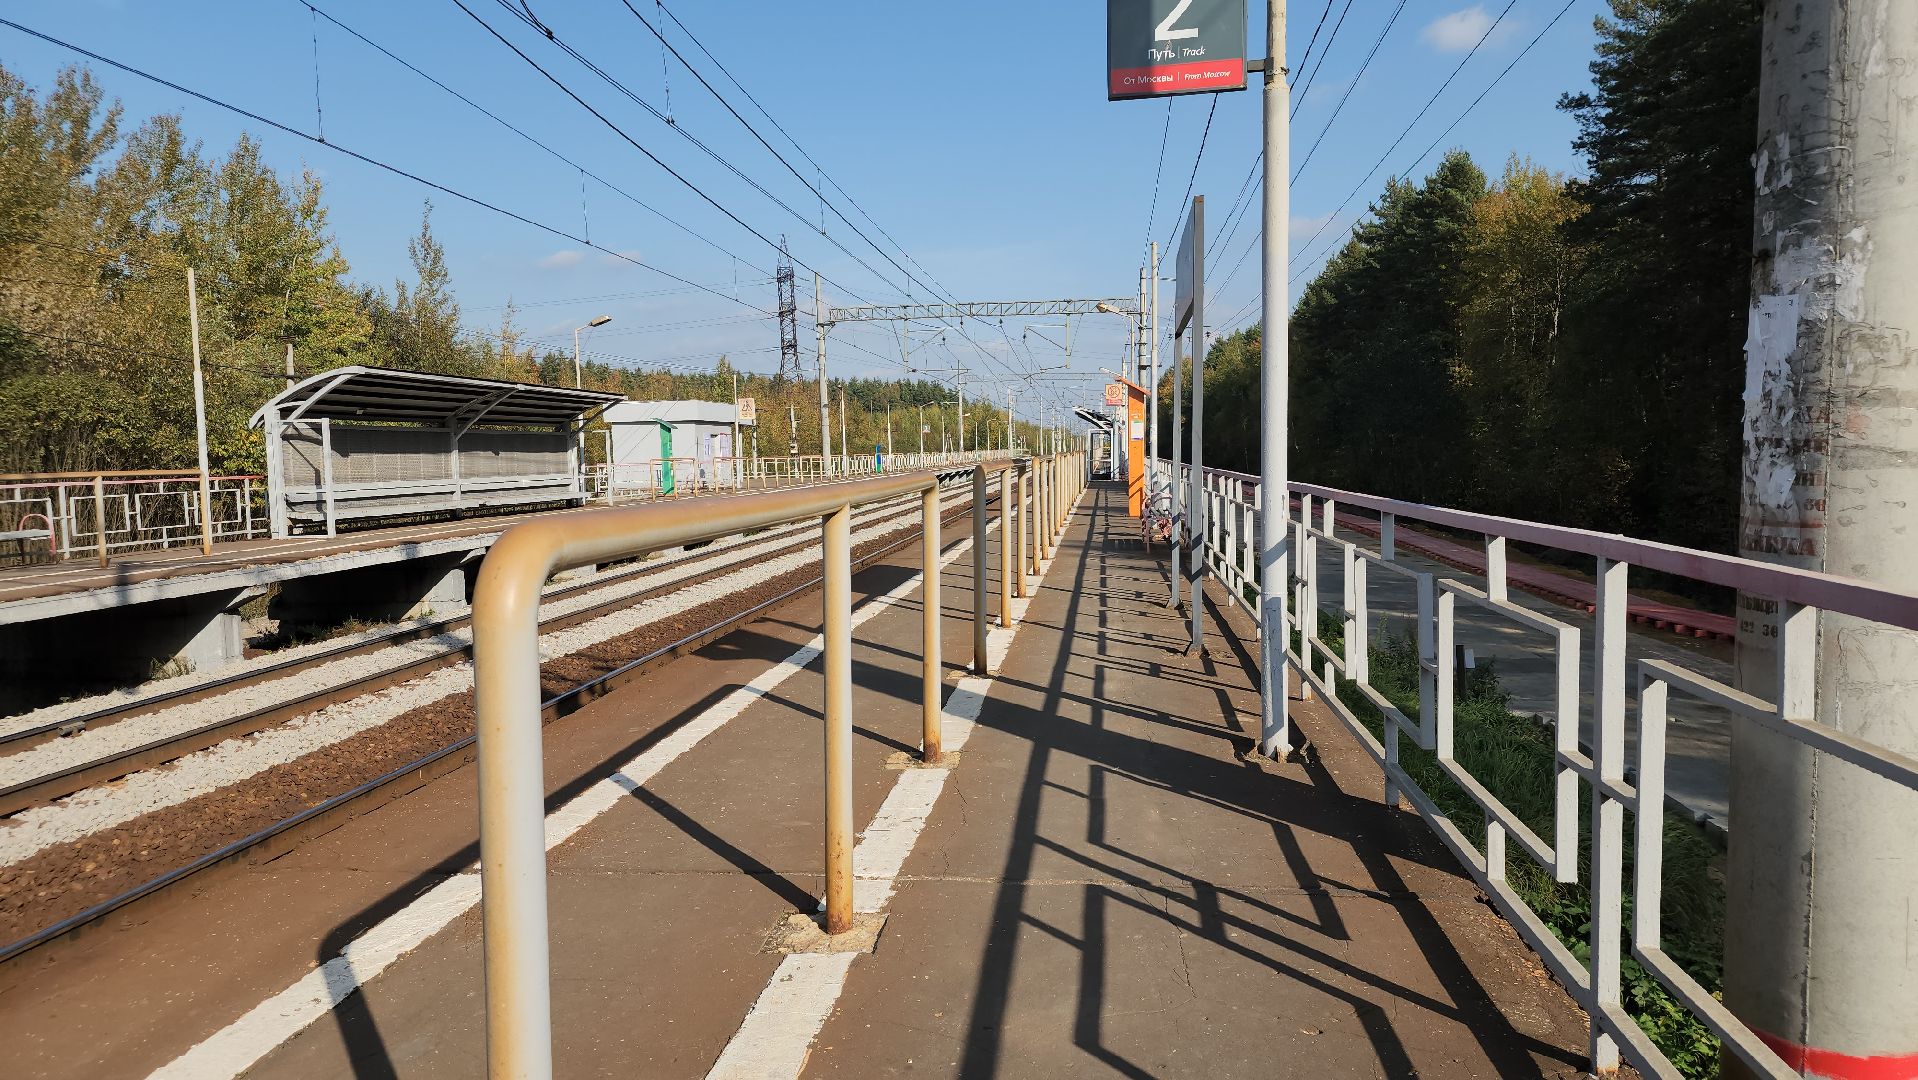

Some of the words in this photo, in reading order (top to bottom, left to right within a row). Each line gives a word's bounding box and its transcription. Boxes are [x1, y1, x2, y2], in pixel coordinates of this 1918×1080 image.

[1155, 0, 1198, 41] 2
[1148, 48, 1175, 61] Путь
[1182, 45, 1206, 57] Track
[1123, 76, 1136, 85] От
[1137, 74, 1174, 84] Москвы
[1184, 73, 1202, 81] From
[1202, 71, 1231, 79] Moscow
